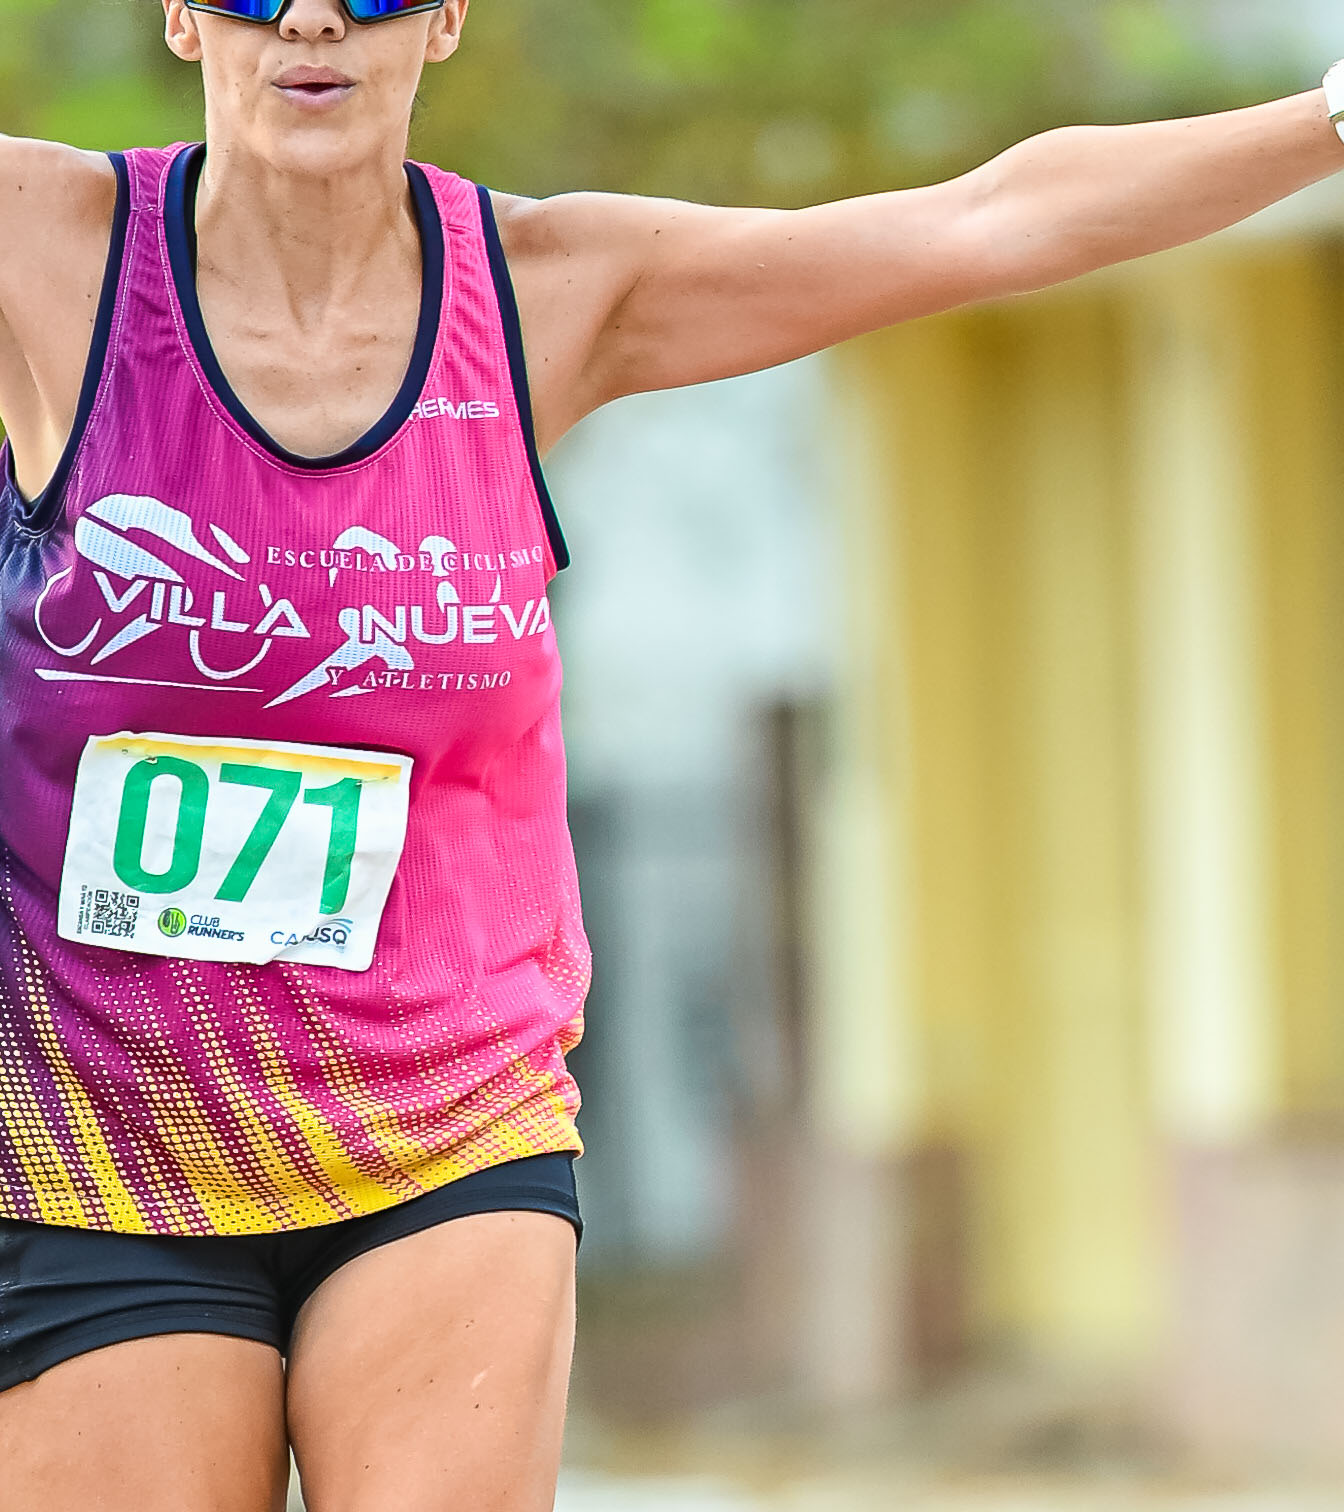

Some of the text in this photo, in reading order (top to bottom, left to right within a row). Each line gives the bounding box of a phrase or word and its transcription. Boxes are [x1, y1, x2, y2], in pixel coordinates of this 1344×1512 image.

[267, 545, 544, 572] ESCUELA DE CICLISMO
[92, 570, 549, 645] VILLA NUEVA
[327, 668, 511, 690] Y ATLETISMO
[113, 756, 361, 915] 071
[190, 914, 220, 927] CLUB
